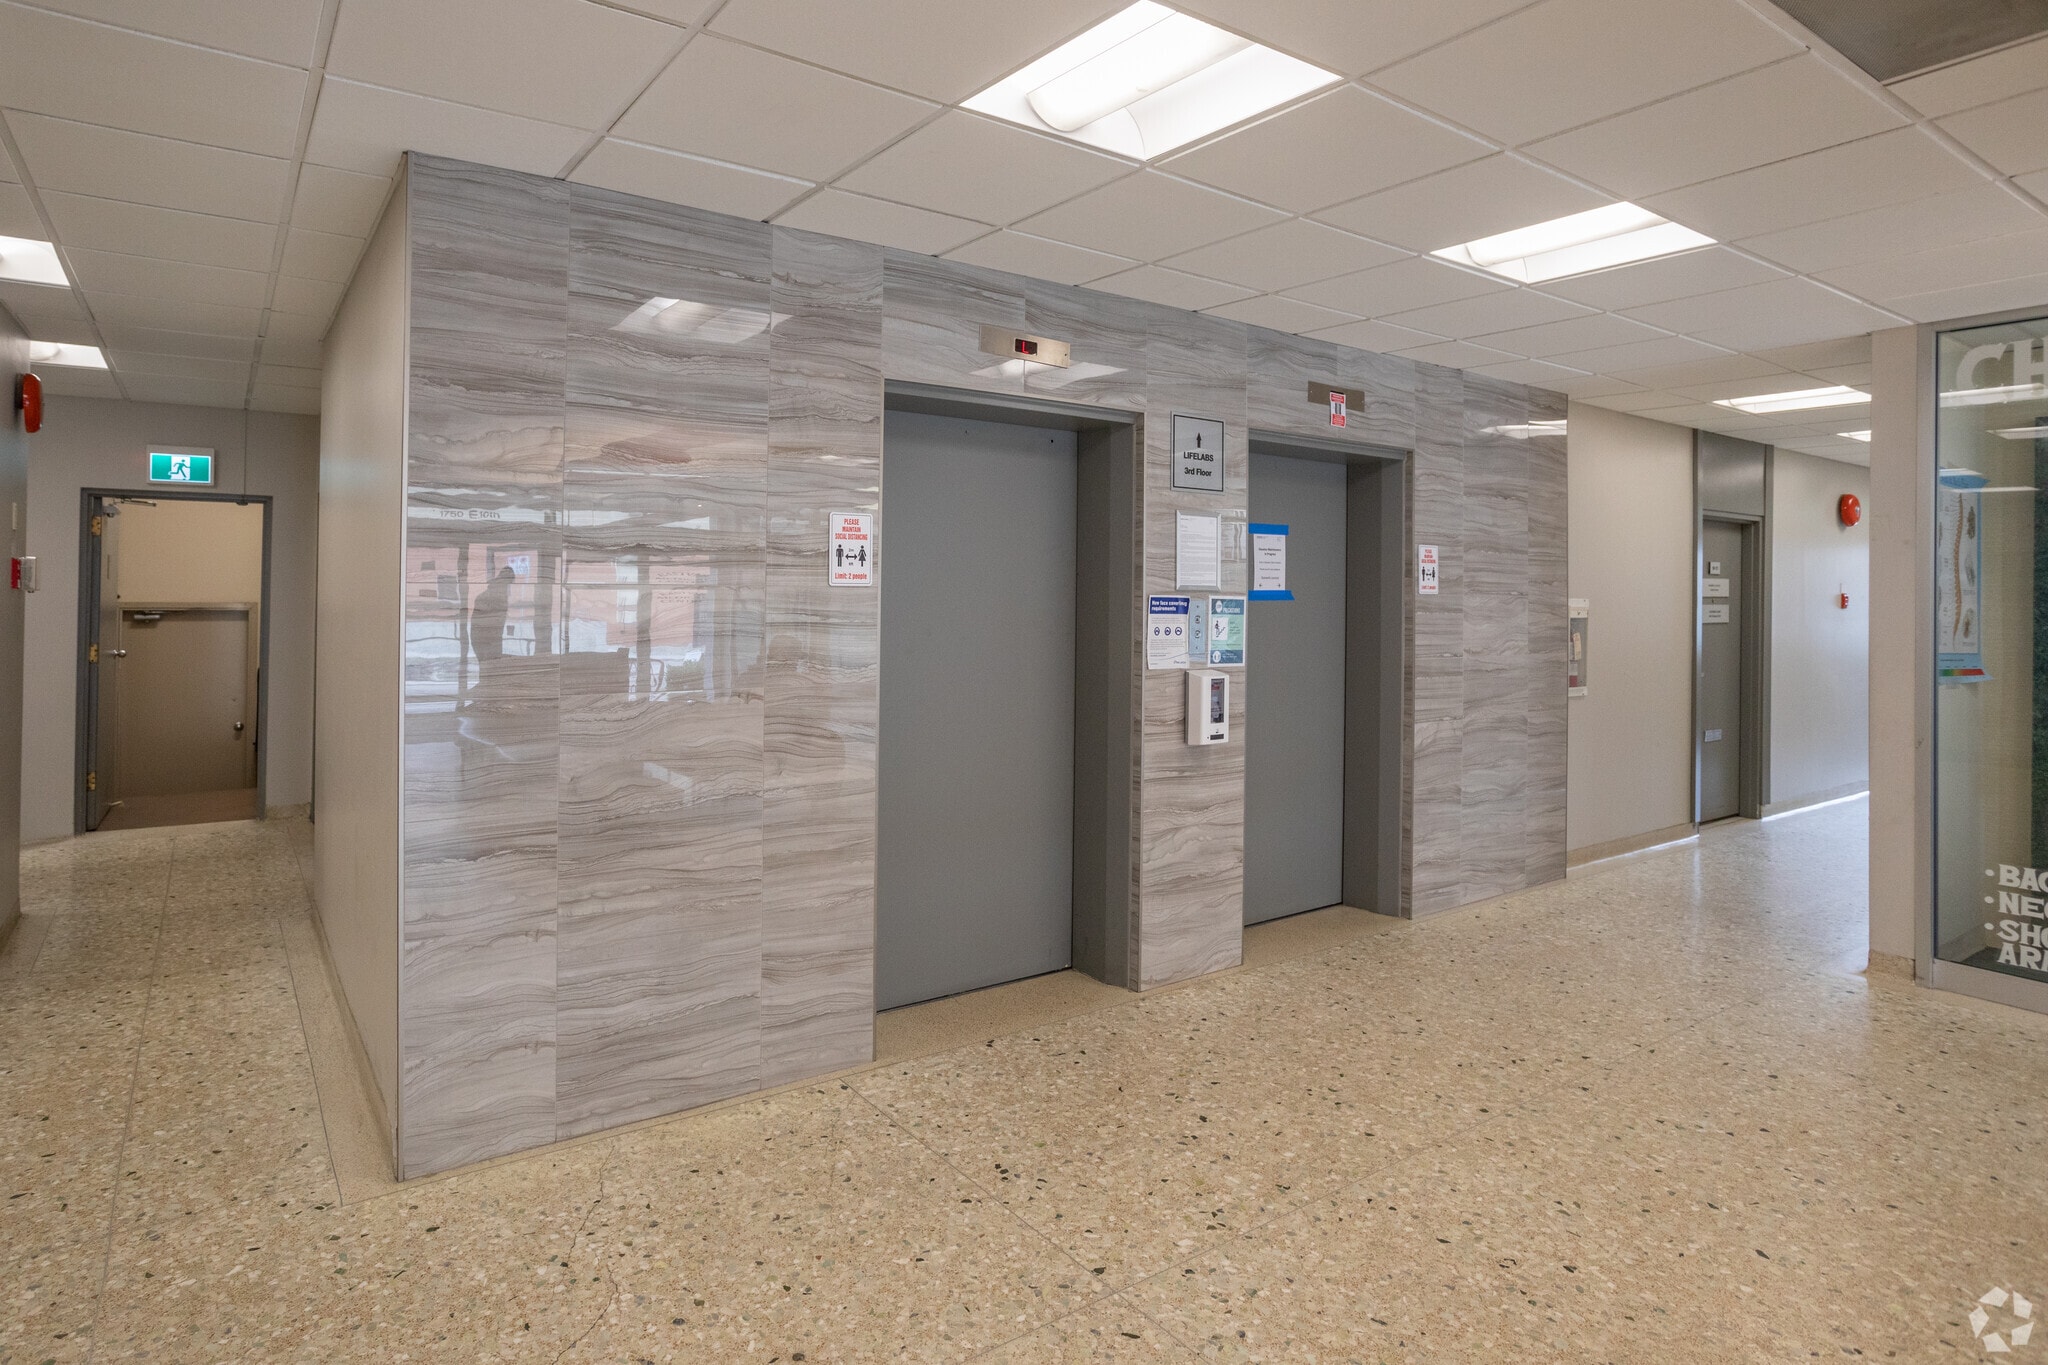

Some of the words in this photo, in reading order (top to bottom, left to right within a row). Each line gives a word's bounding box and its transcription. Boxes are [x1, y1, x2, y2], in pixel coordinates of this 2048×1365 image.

[1022, 340, 1030, 354] L
[1183, 451, 1214, 462] LIFELABS
[1184, 467, 1195, 475] 3rd
[1196, 468, 1212, 477] Floor
[440, 510, 464, 518] 1750
[1998, 890, 2048, 921] NE
